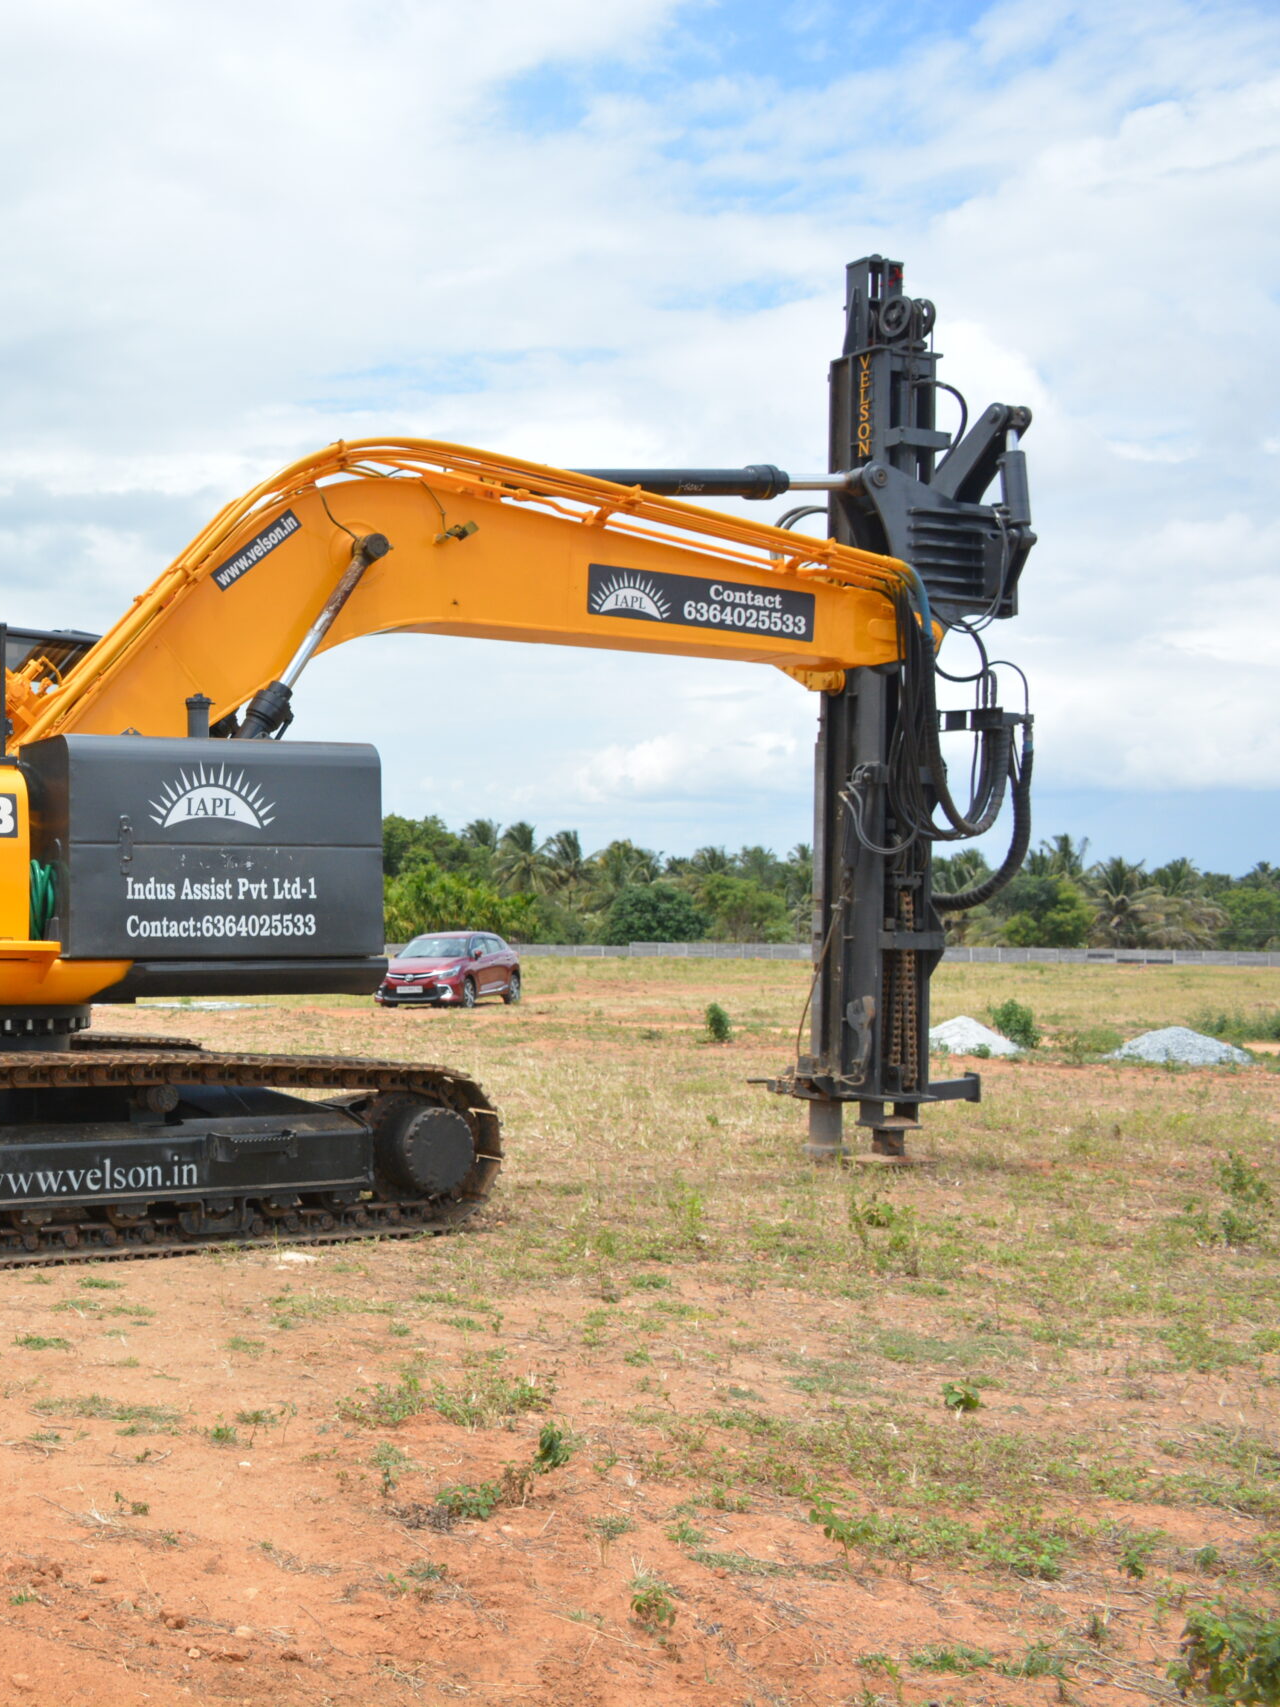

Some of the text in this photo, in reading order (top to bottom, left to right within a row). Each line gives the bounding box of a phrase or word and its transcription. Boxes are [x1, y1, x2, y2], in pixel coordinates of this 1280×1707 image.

[857, 353, 872, 458] VELSON
[216, 515, 297, 587] www.velson.in
[613, 594, 647, 610] IAPL
[709, 584, 783, 610] Contact
[682, 600, 807, 635] 6364025533
[184, 797, 236, 817] IAPL
[126, 876, 318, 901] Indus Assist Pvt Ltd-1
[126, 913, 317, 938] Contact:6364025533
